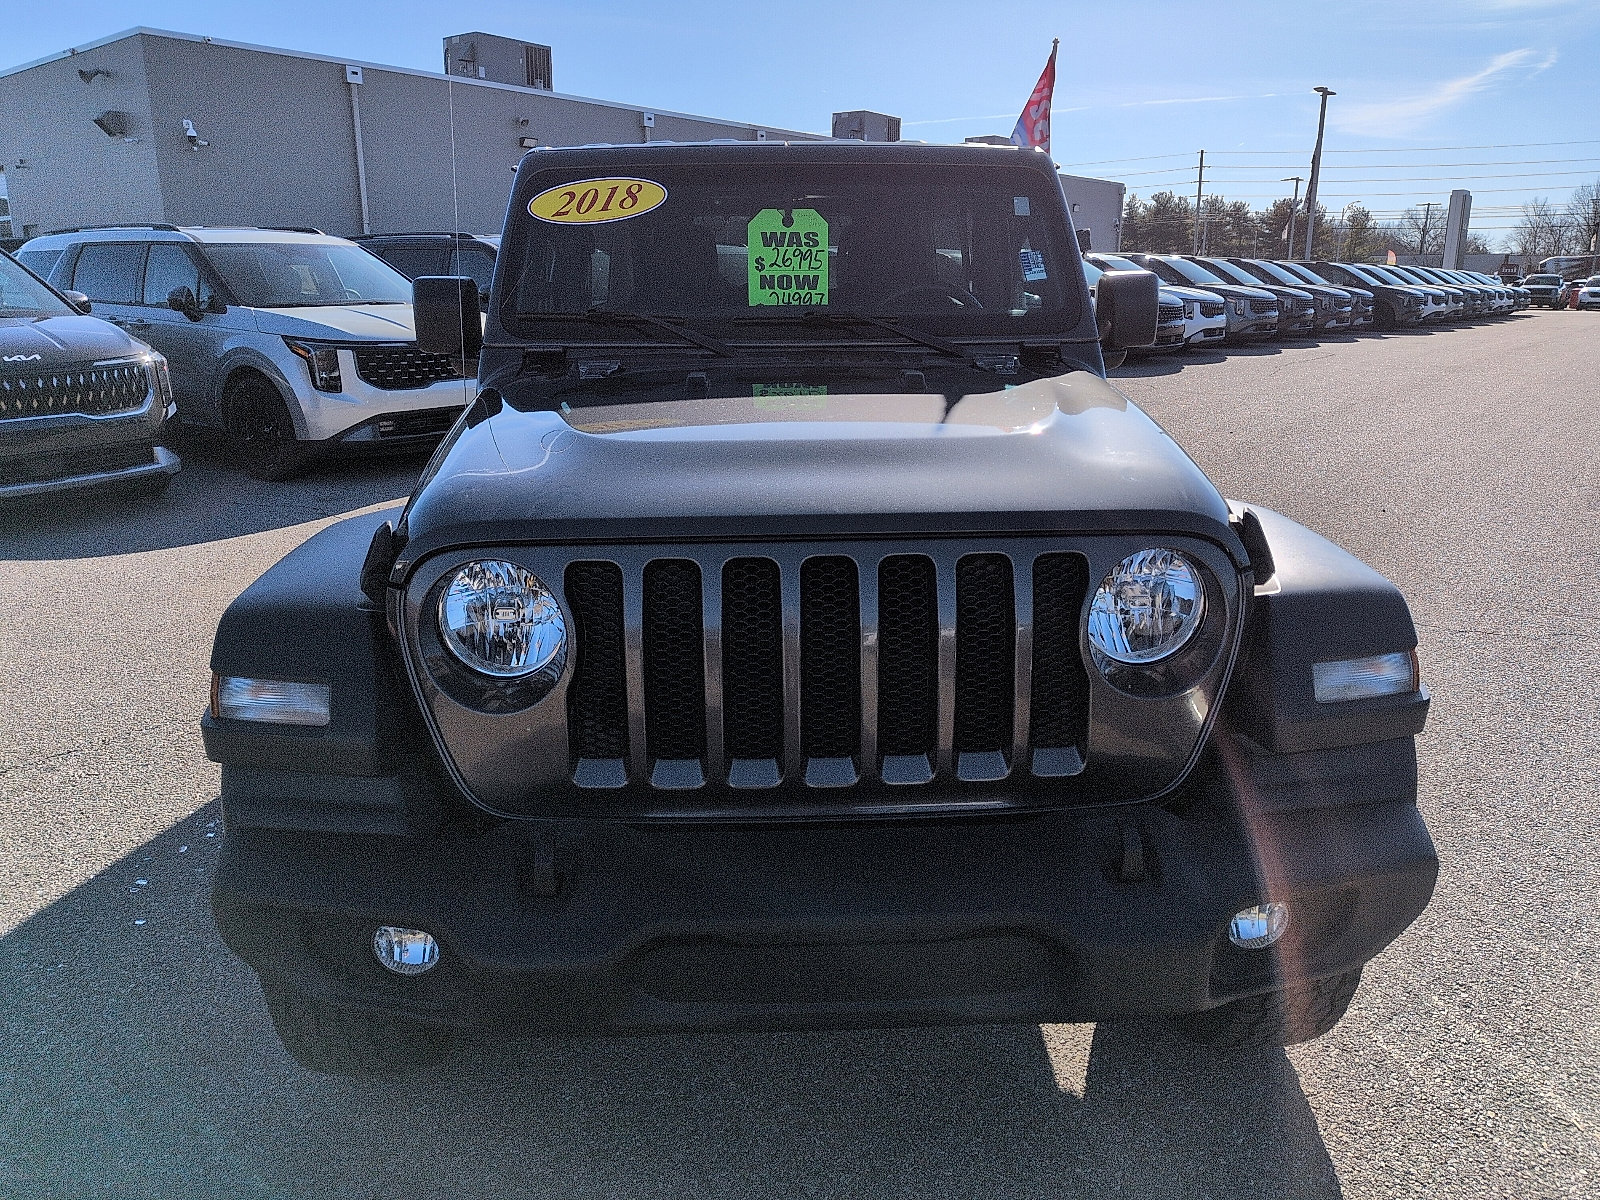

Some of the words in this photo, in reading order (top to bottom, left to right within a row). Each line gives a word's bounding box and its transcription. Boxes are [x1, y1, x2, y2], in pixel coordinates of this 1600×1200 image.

[551, 183, 643, 217] 2018
[761, 231, 820, 248] WAS
[760, 274, 819, 290] NOW
